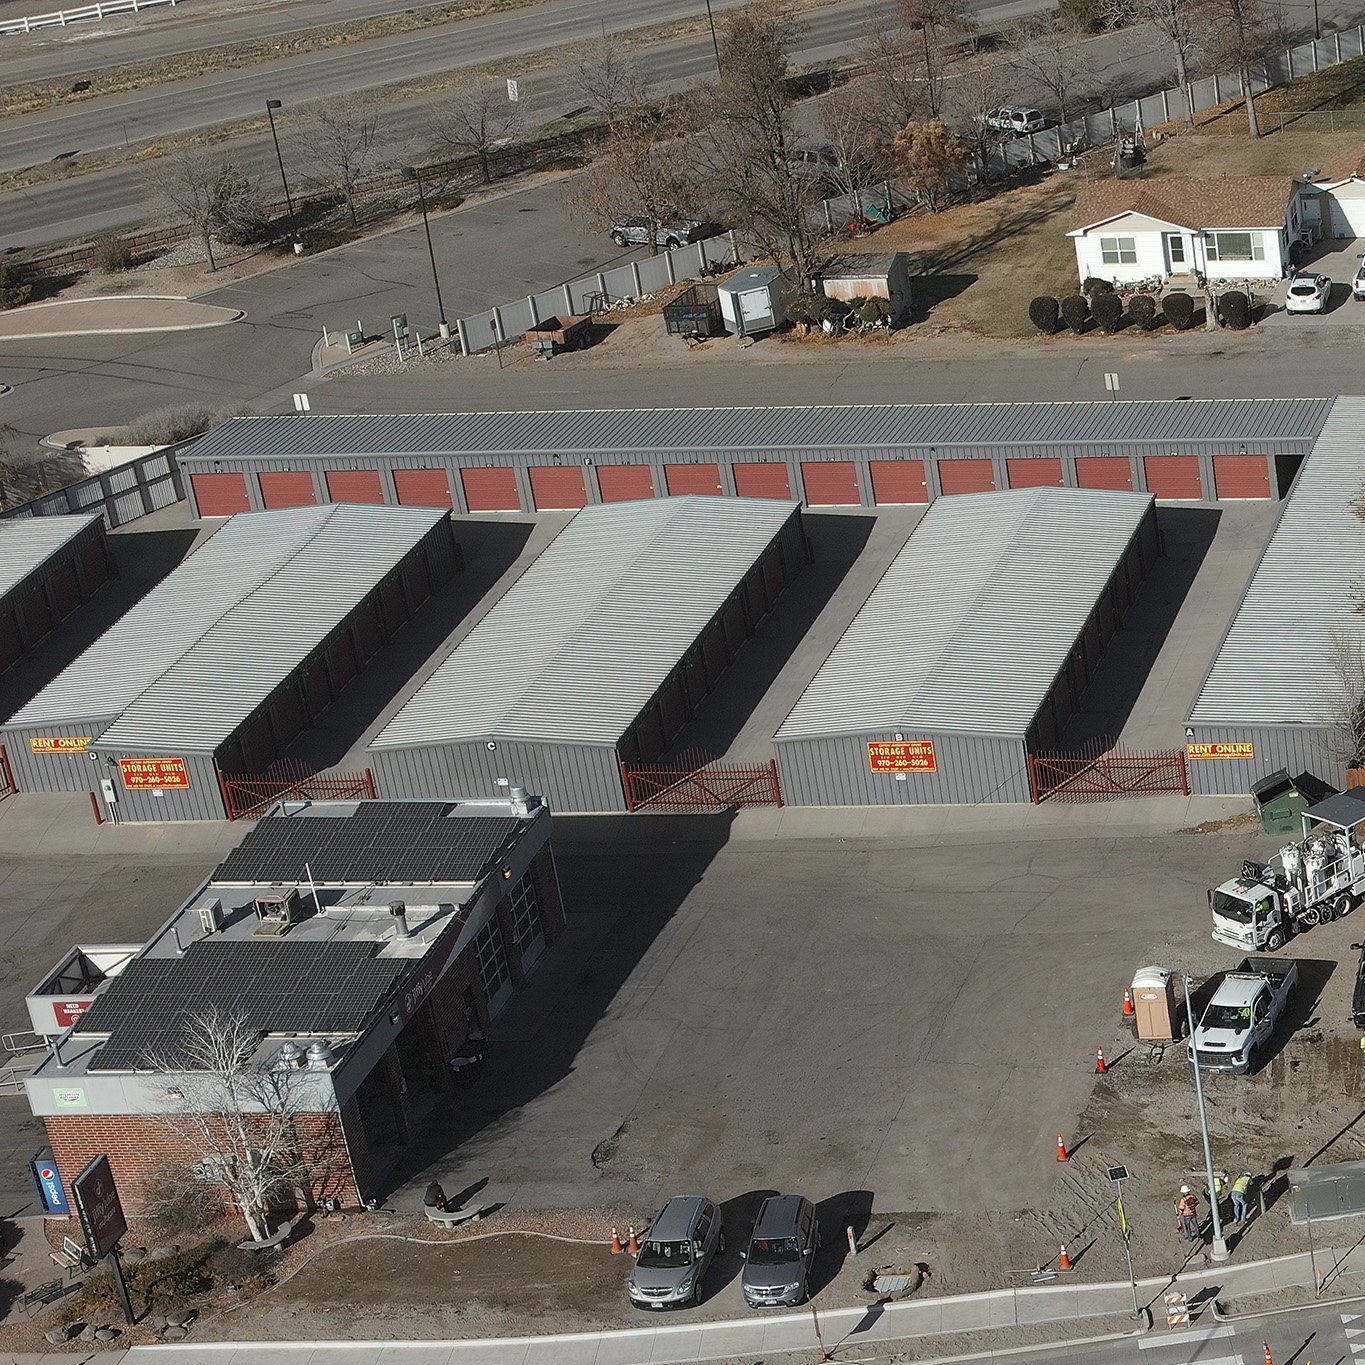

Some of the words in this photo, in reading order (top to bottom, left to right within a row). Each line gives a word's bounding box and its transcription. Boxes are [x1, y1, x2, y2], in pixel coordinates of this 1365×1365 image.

[1186, 728, 1194, 736] A
[895, 733, 903, 741] B
[32, 739, 55, 748] RENT
[58, 738, 91, 747] ONLIN
[487, 742, 496, 750] C
[869, 747, 905, 756] STORAGE
[909, 746, 932, 755] UNITS
[1188, 745, 1213, 753] RENT
[1215, 744, 1252, 753] ONLINE
[89, 752, 97, 760] D
[877, 759, 929, 767] 970-260-5026
[123, 764, 157, 772] STORAGE
[160, 763, 184, 772] UNITS
[46, 1181, 61, 1205] pepsi
